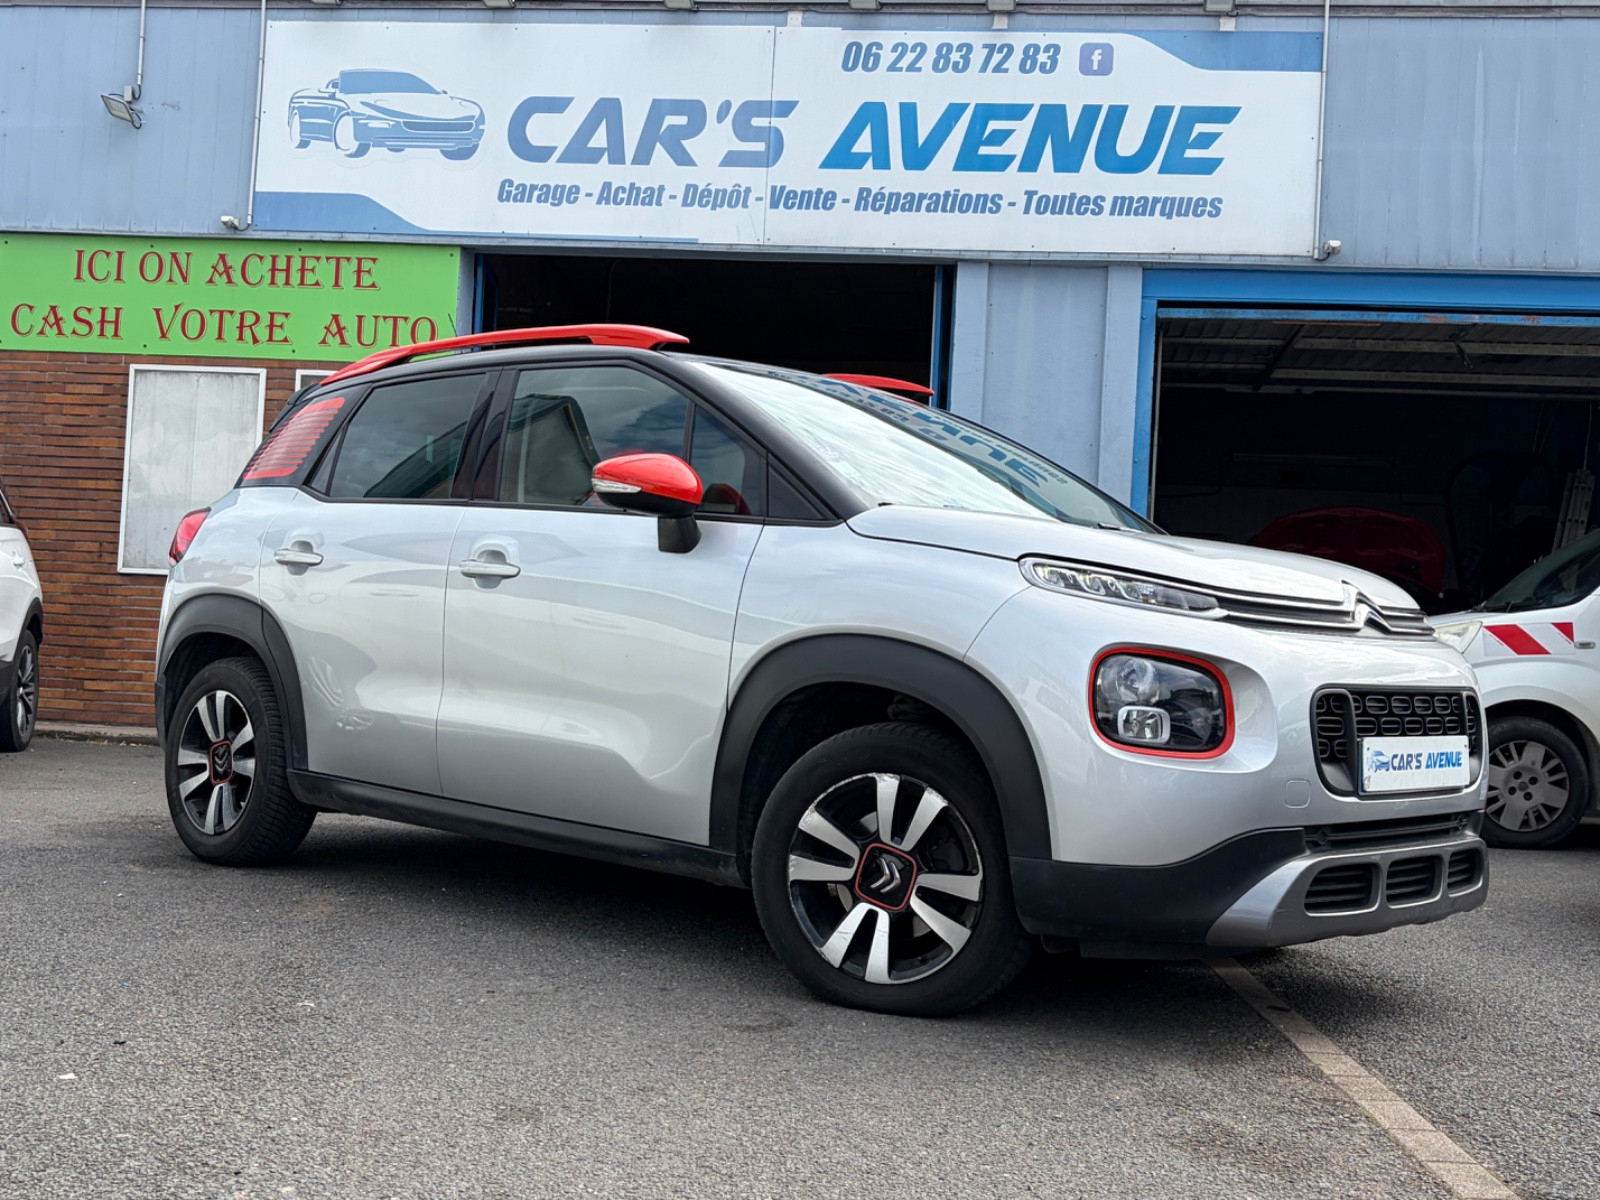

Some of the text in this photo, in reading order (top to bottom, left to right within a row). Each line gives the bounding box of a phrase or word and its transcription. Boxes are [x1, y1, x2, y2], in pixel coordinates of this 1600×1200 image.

[841, 41, 1061, 74] 06 22 83 72 83
[507, 96, 1242, 176] CAR'S AVENUE
[497, 178, 580, 207] Garage
[596, 181, 665, 207] Achat
[681, 183, 752, 211] Dépôt
[769, 185, 837, 211] Vente
[854, 186, 1004, 215] Réparations
[1022, 190, 1105, 217] Toutes
[1109, 194, 1223, 220] marques
[74, 249, 380, 291] ICI ON ACHETE
[10, 302, 438, 347] CASH VOTRE AUTO
[1391, 751, 1462, 771] CAR'S AVENUE
